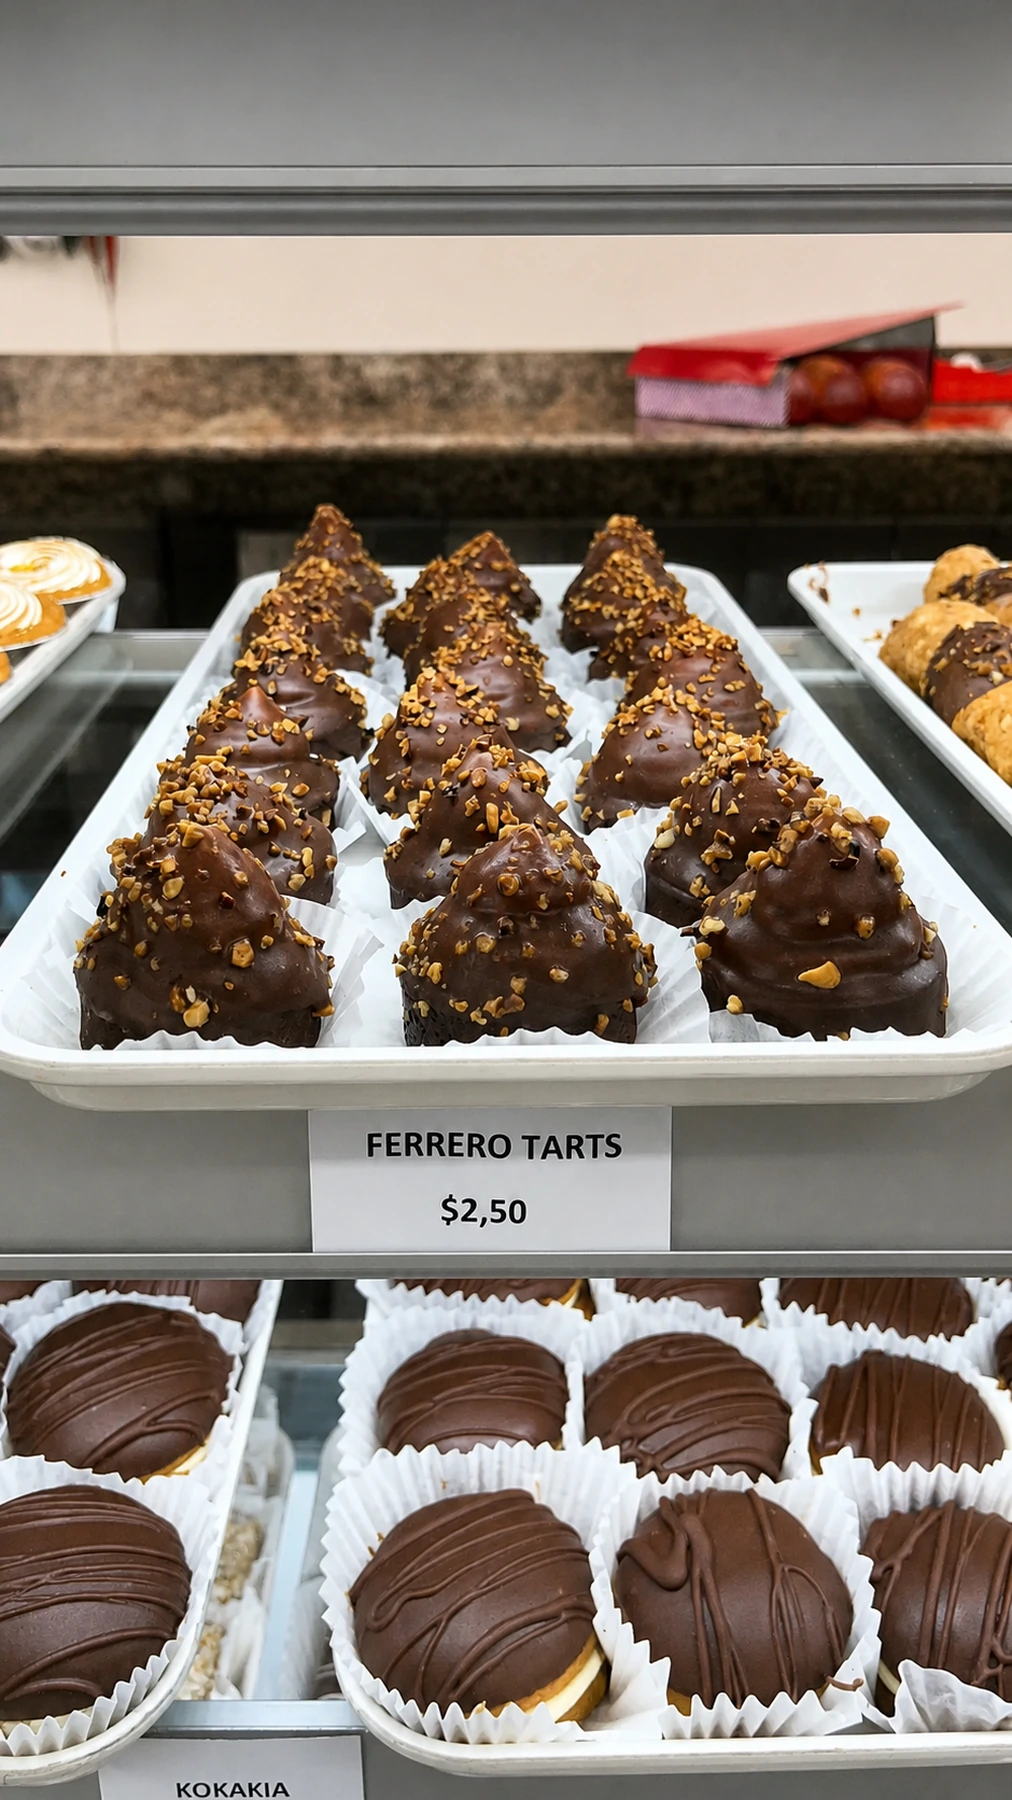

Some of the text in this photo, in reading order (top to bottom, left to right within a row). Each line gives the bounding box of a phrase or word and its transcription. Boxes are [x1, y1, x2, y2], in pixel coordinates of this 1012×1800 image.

[366, 1131, 623, 1160] FERRERO TARTS
[440, 1193, 527, 1228] $2,50
[175, 1781, 291, 1799] KOKAKIA
